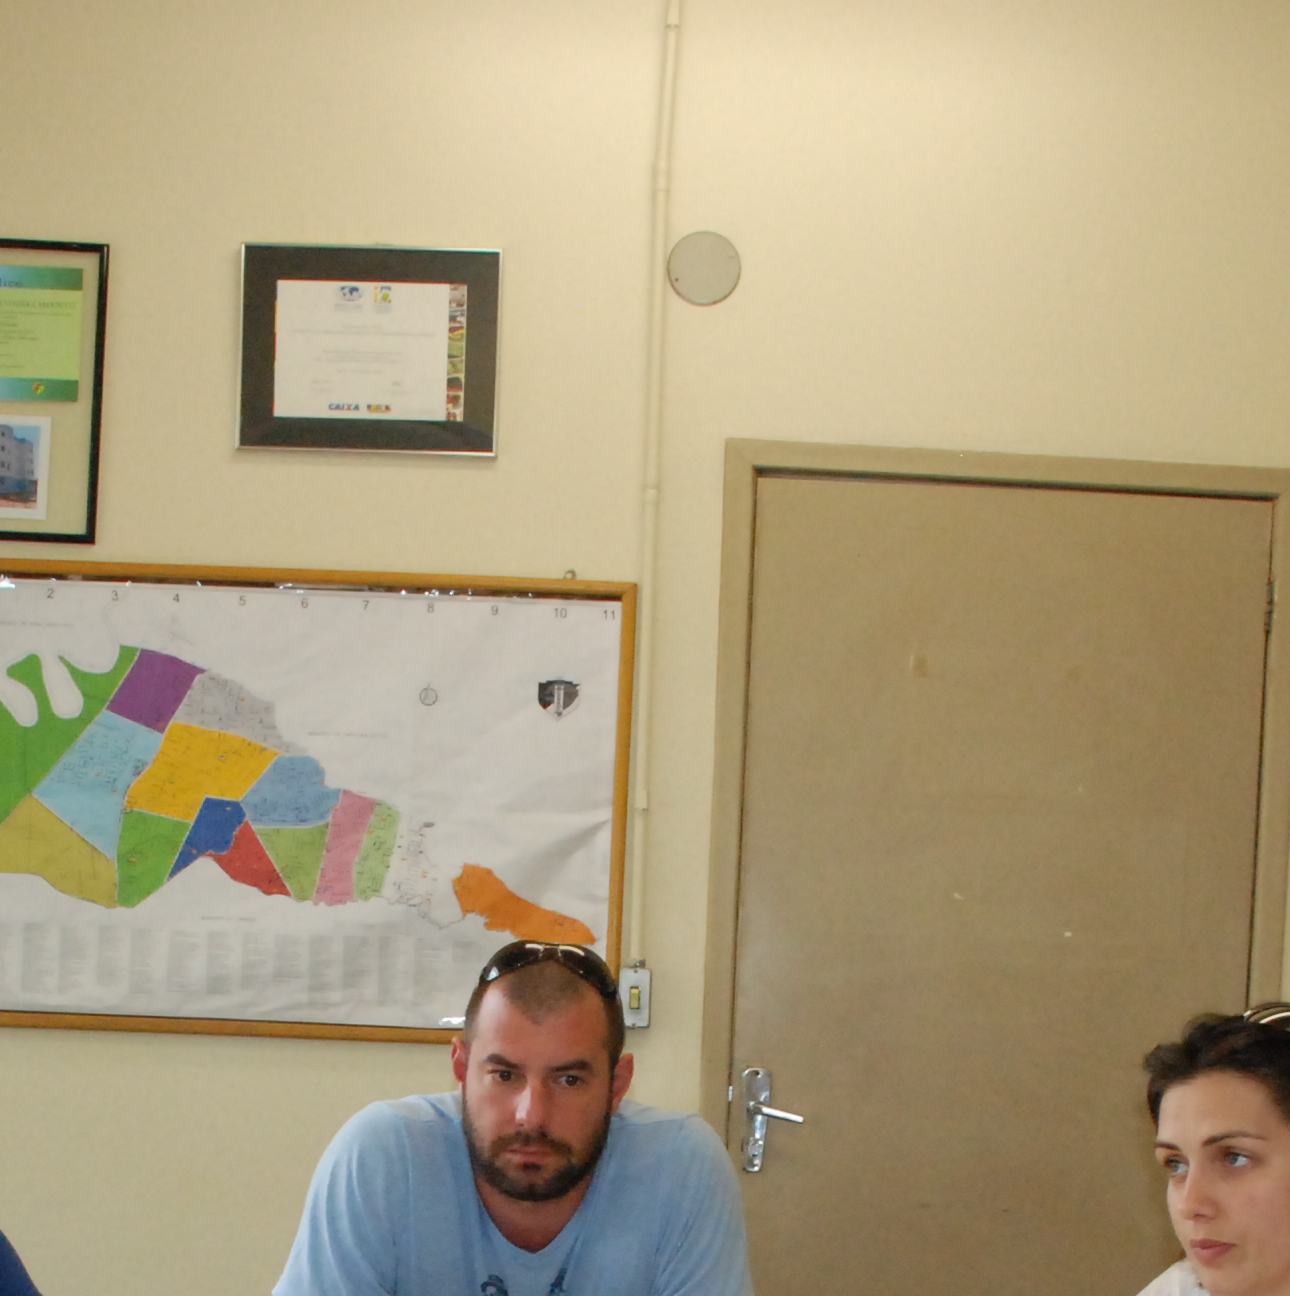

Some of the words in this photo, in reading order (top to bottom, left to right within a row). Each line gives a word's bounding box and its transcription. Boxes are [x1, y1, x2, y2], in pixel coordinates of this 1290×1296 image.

[47, 588, 54, 599] 2
[111, 590, 119, 601] 3
[172, 593, 180, 603] 4
[238, 595, 246, 606] 5
[301, 597, 309, 608] 6
[362, 600, 370, 610] 7
[427, 603, 435, 613] 8
[491, 605, 498, 616] 9
[554, 607, 567, 619] 10
[603, 610, 616, 620] 11
